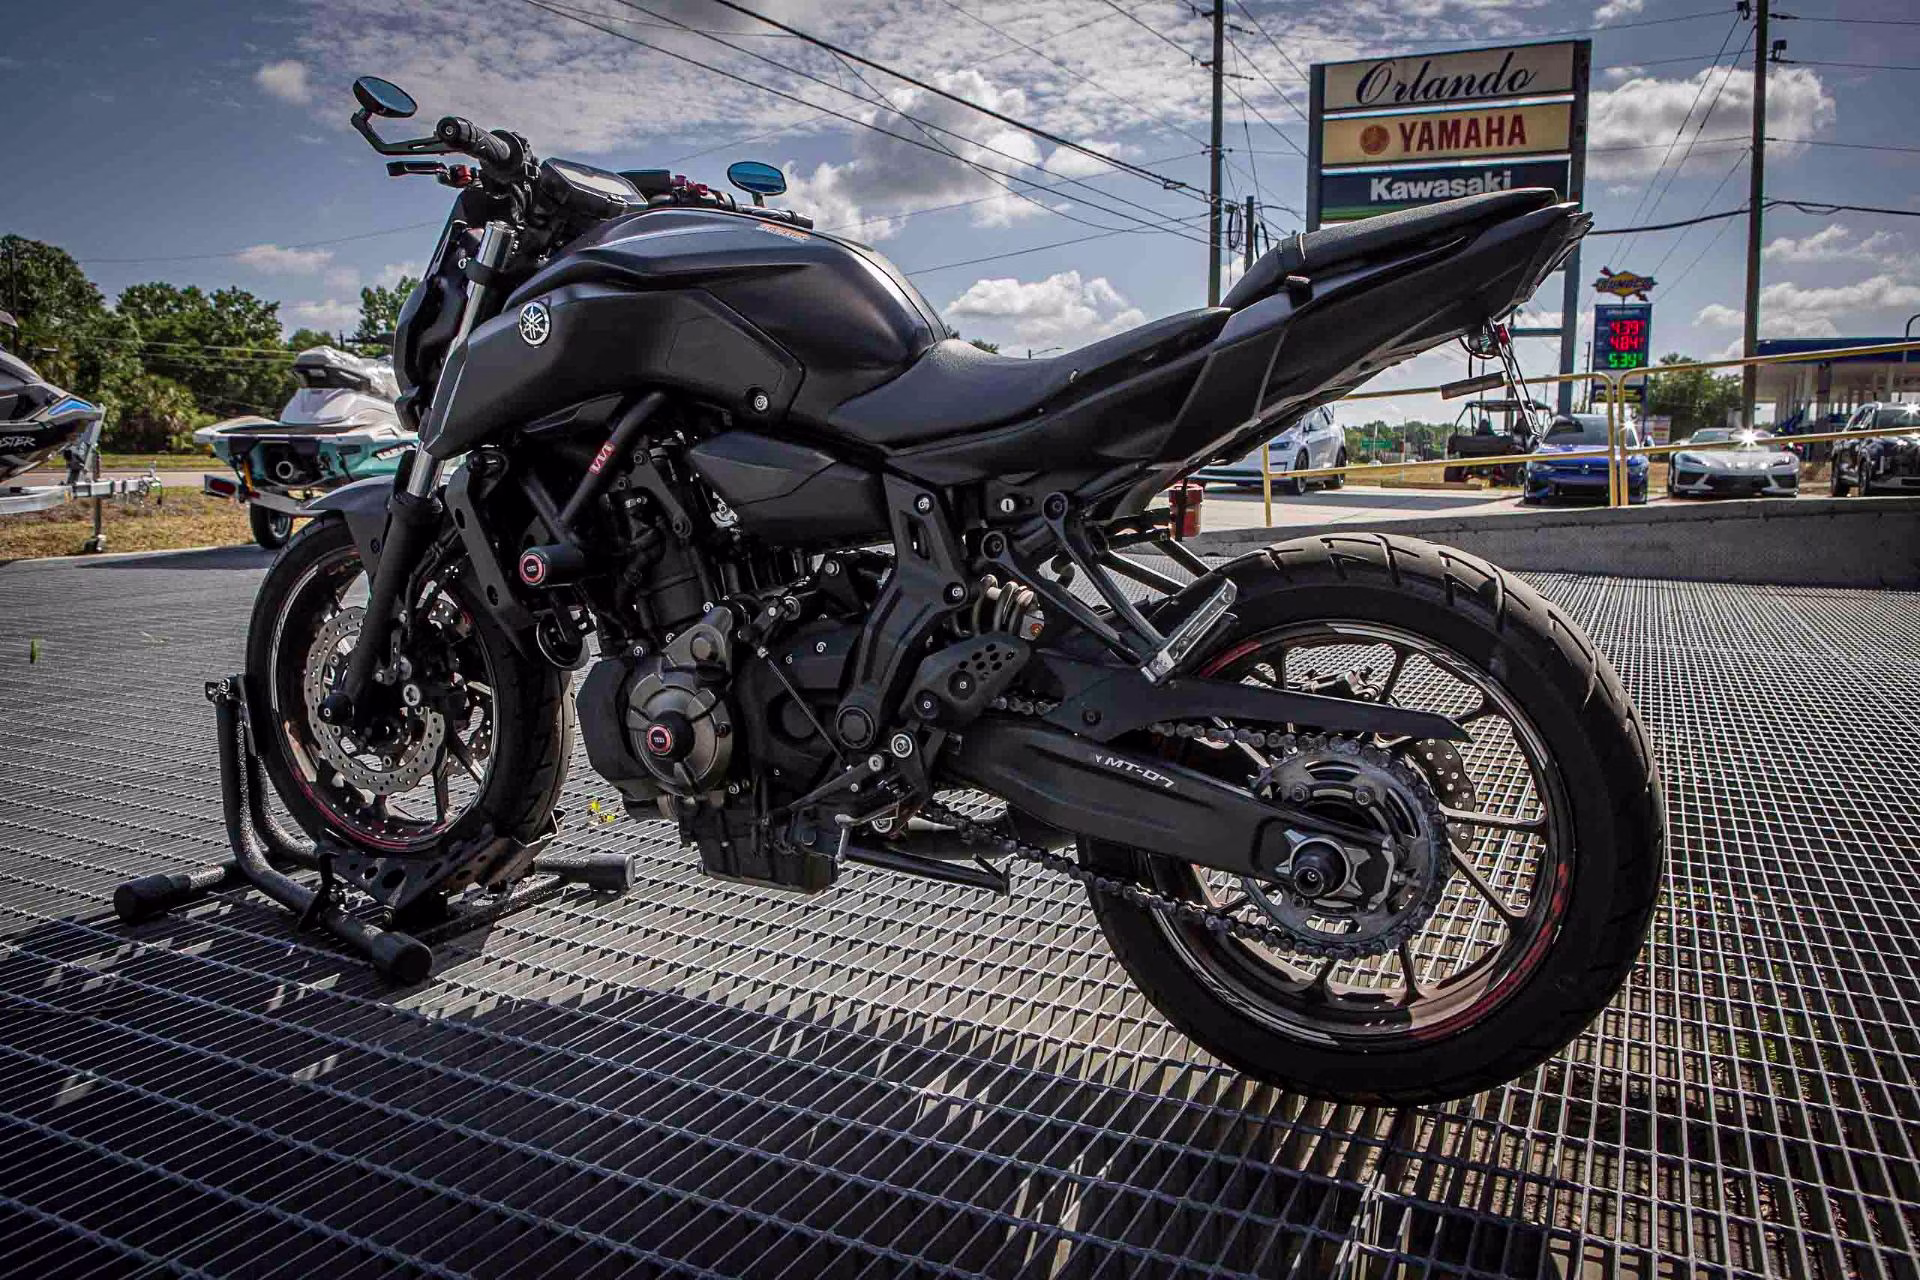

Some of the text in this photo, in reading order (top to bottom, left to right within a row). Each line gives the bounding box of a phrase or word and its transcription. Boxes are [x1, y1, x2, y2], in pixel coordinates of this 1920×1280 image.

[1355, 51, 1537, 105] Orlando
[1398, 113, 1527, 153] YAMAHA
[1369, 170, 1512, 202] Kawasaki
[1104, 757, 1175, 788] MT-07
